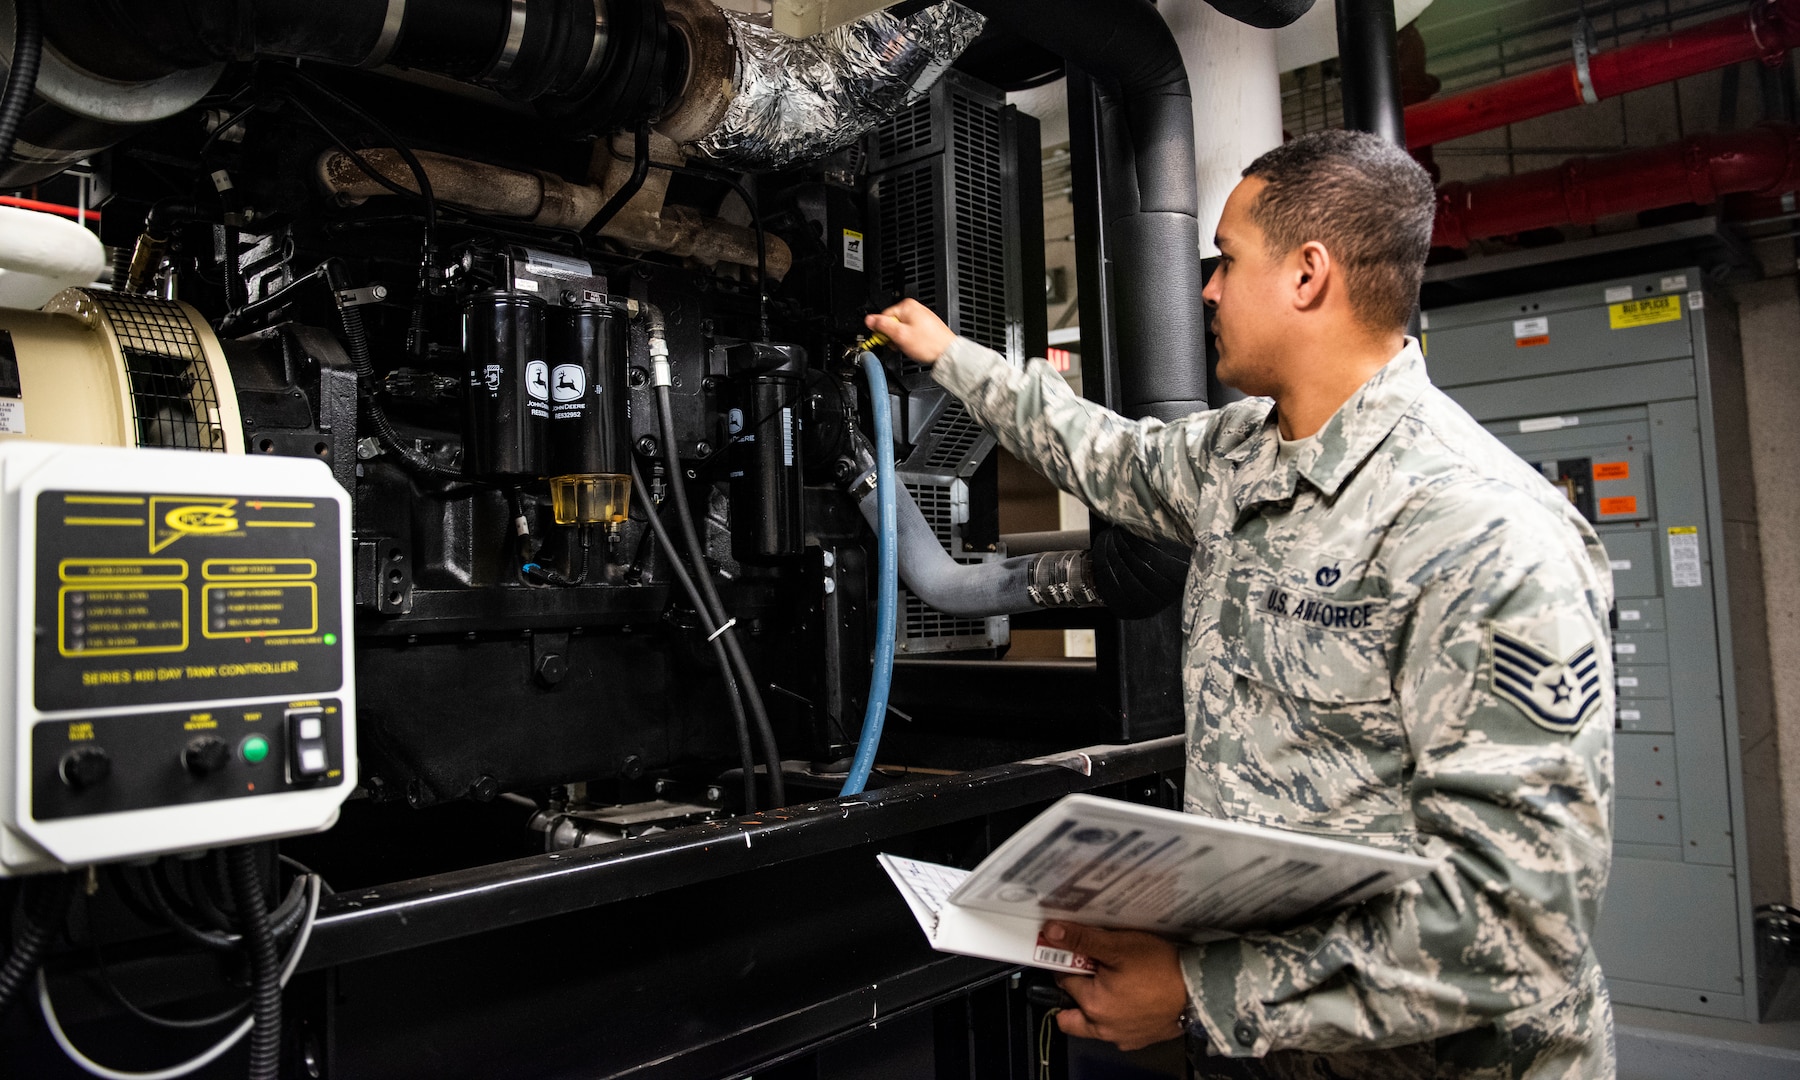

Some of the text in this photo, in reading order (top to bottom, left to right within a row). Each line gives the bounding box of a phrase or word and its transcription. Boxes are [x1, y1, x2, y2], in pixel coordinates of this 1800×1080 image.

[1267, 589, 1288, 615] U.S.
[1313, 602, 1372, 628] FORCE
[82, 669, 132, 685] SERIES
[157, 667, 184, 681] DAY
[185, 665, 217, 680] TANK
[218, 660, 298, 677] CONTROLLER
[867, 738, 875, 751] BLUE
